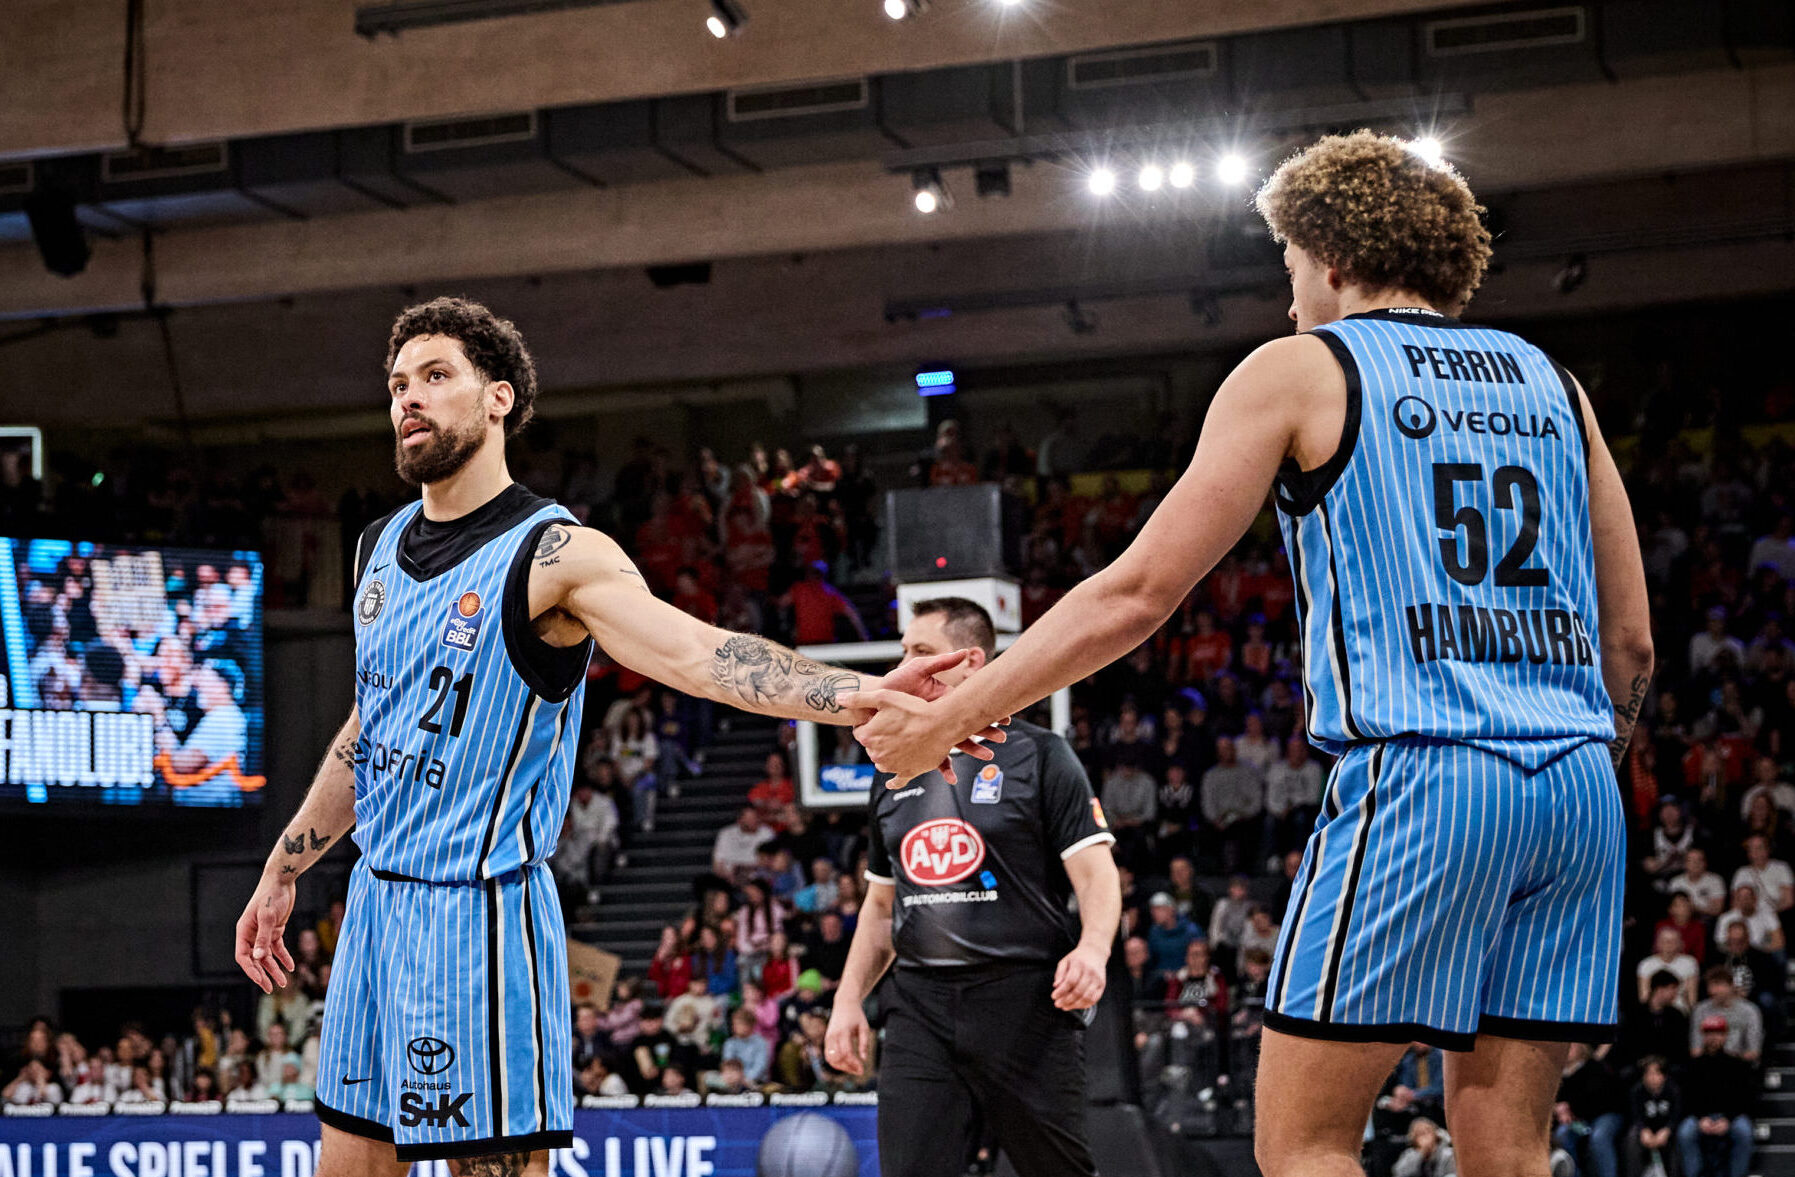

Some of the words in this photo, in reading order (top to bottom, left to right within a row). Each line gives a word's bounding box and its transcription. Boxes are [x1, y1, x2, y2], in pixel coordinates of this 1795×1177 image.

[1402, 344, 1526, 384] PERRIN
[1442, 409, 1562, 441] VEOLIA
[1432, 463, 1549, 587] 52
[539, 556, 561, 568] TMC
[445, 630, 473, 646] BBL
[1406, 602, 1594, 667] HAMBURG
[418, 665, 474, 738] 21
[400, 1079, 452, 1091] Autohaus
[400, 1092, 475, 1128] S+K
[109, 1141, 267, 1177] SPIELE
[604, 1136, 717, 1177] LIVE
